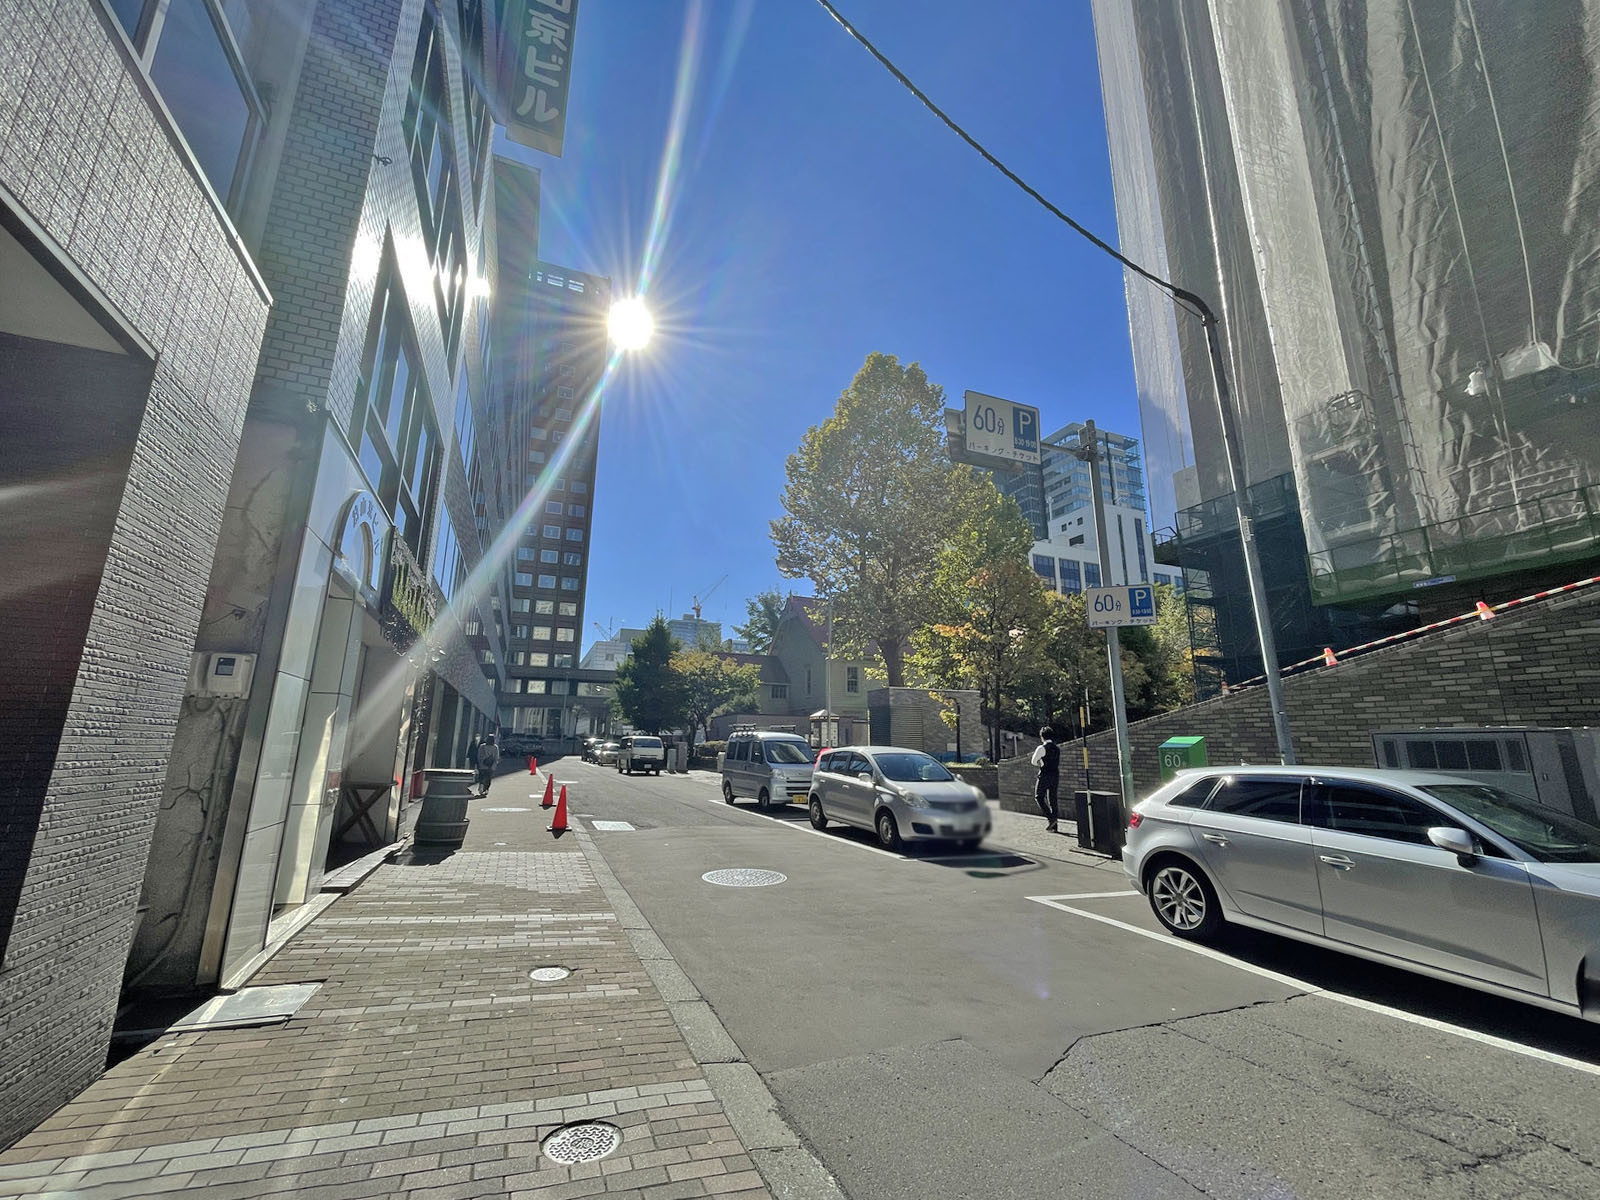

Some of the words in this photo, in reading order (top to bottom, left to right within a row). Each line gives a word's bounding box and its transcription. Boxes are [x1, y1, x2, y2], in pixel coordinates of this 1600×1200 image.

[973, 404, 1005, 436] 60分
[1019, 410, 1032, 435] P
[1094, 594, 1122, 612] 60分
[1134, 589, 1147, 607] P
